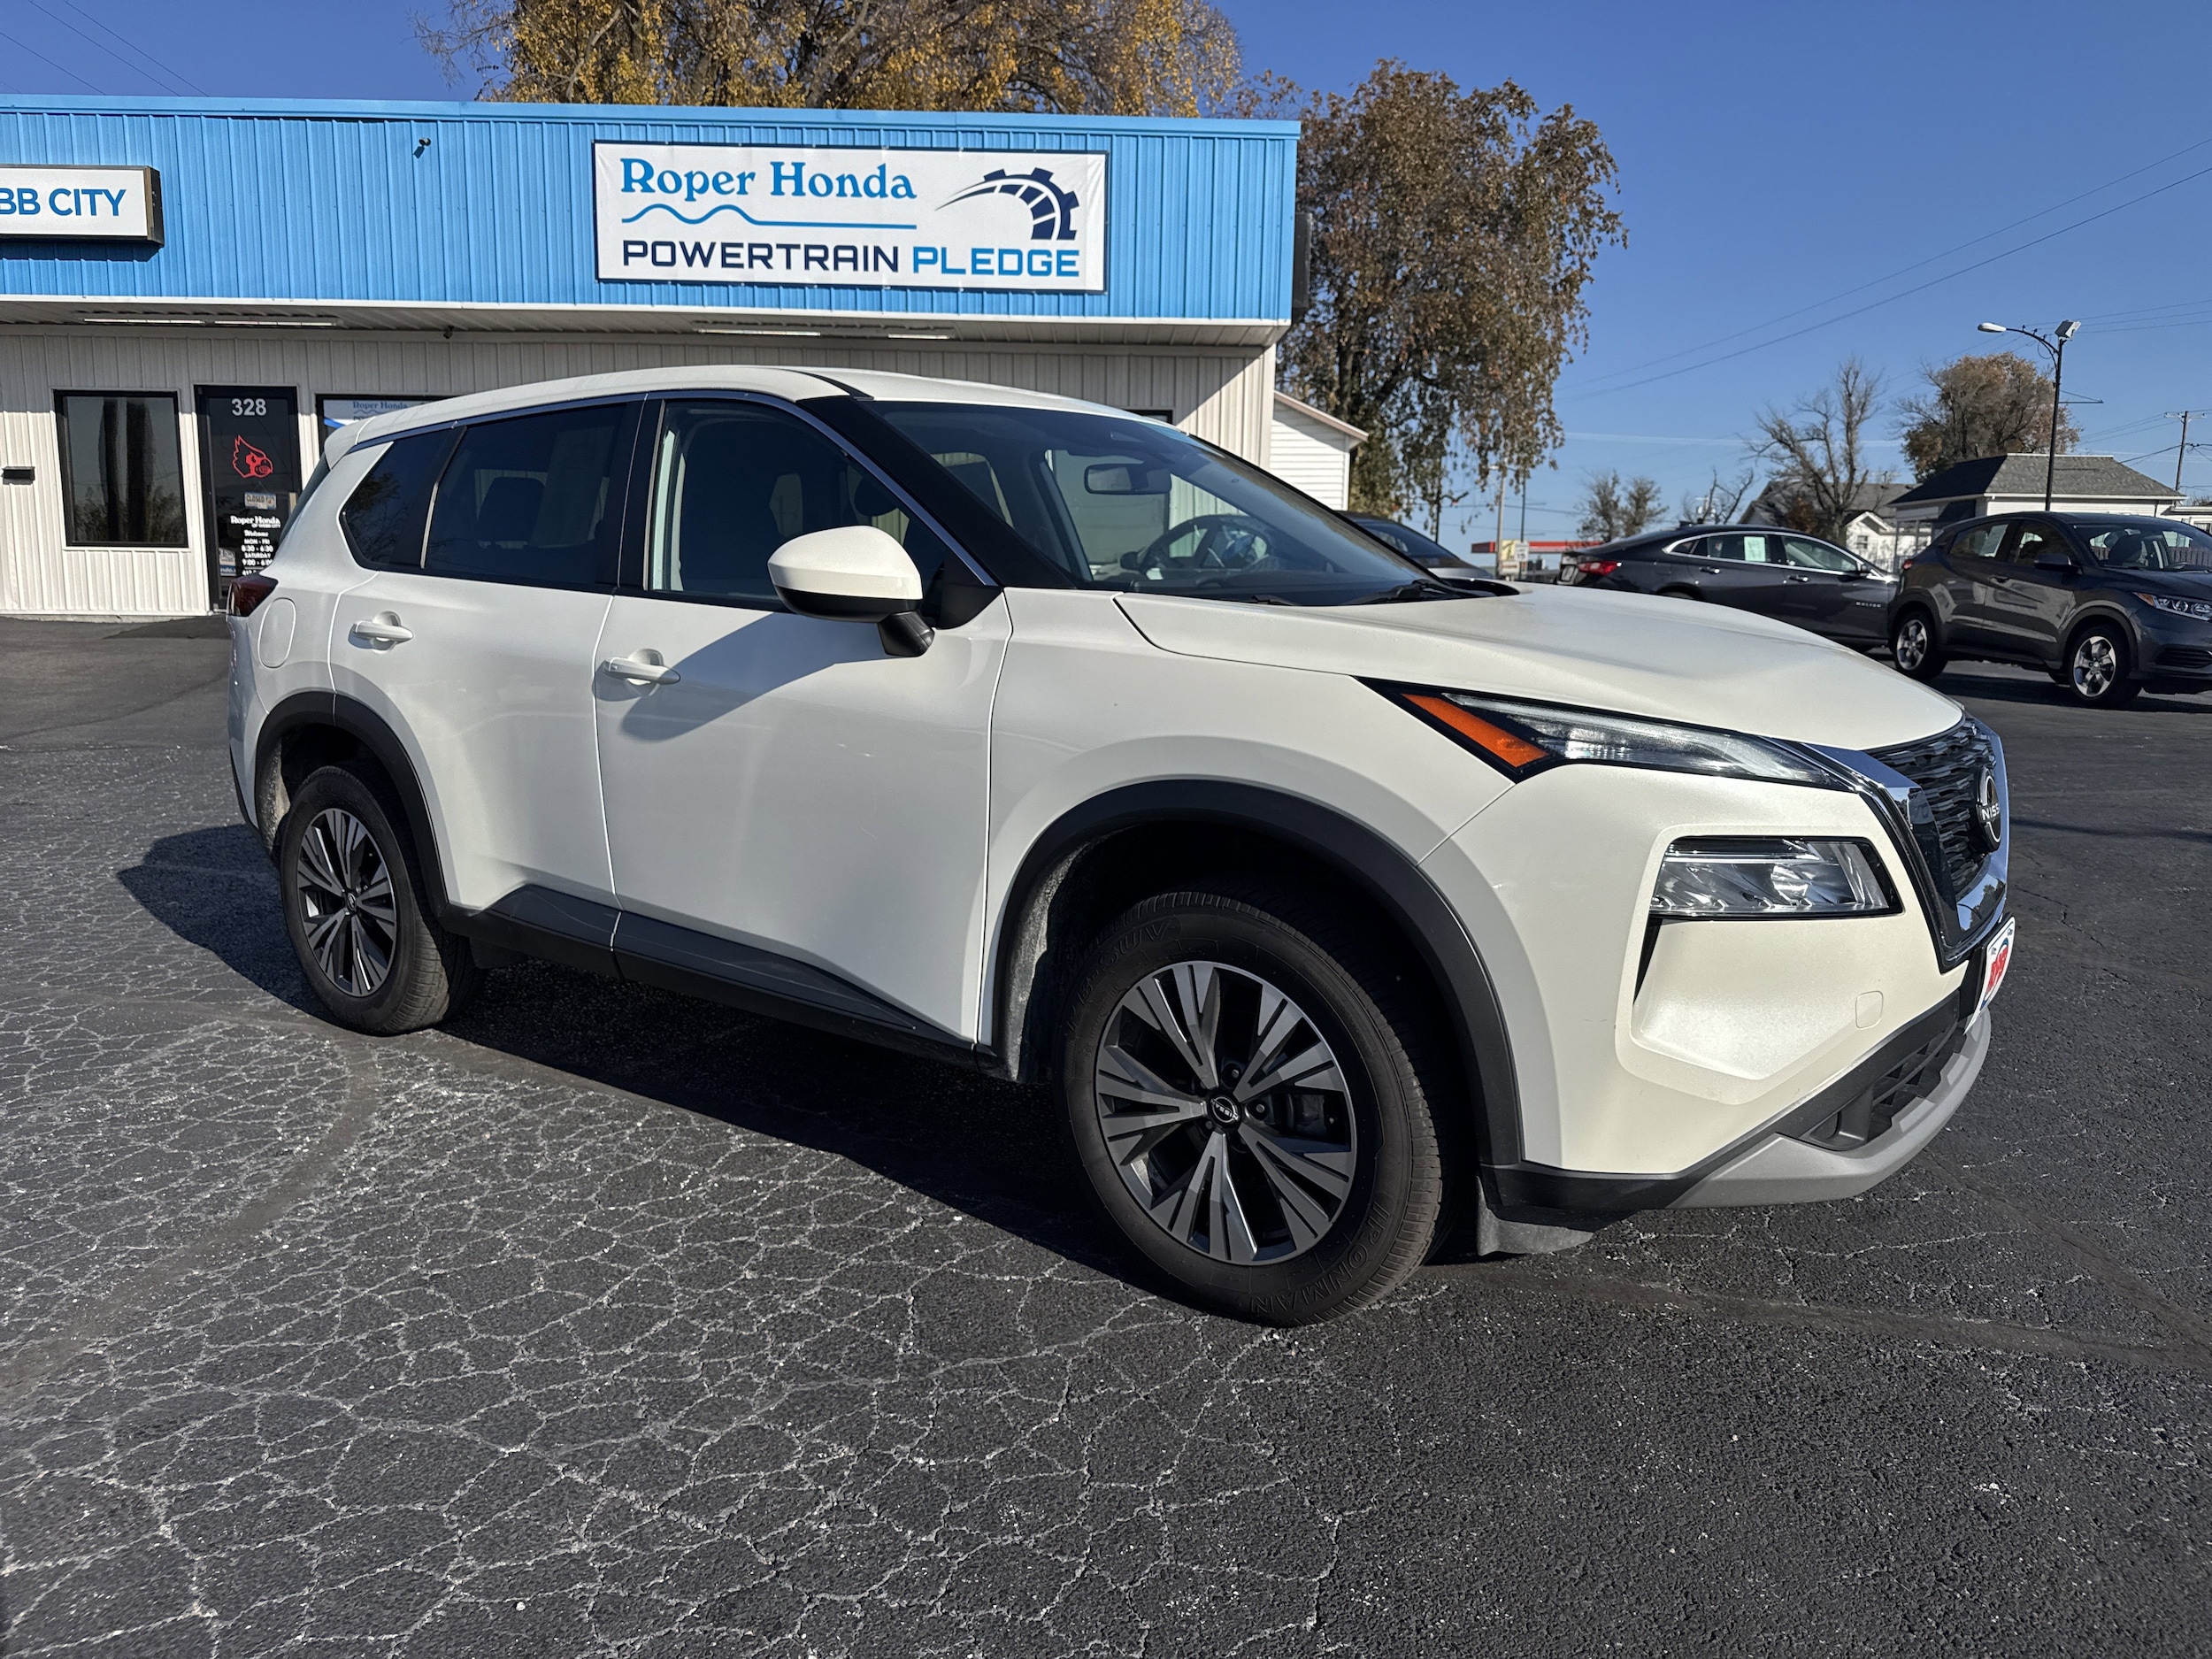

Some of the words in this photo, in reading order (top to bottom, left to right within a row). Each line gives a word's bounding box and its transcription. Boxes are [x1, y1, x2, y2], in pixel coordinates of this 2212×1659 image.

[620, 158, 756, 202] Roper
[770, 161, 918, 199] Honda
[49, 188, 127, 217] CITY
[623, 240, 899, 273] POWERTRAIN
[913, 246, 1079, 277] PLEDGE
[231, 398, 267, 416] 328
[353, 401, 379, 410] Roper
[230, 515, 254, 525] Roper
[1249, 1200, 1392, 1315] IRONMAN
